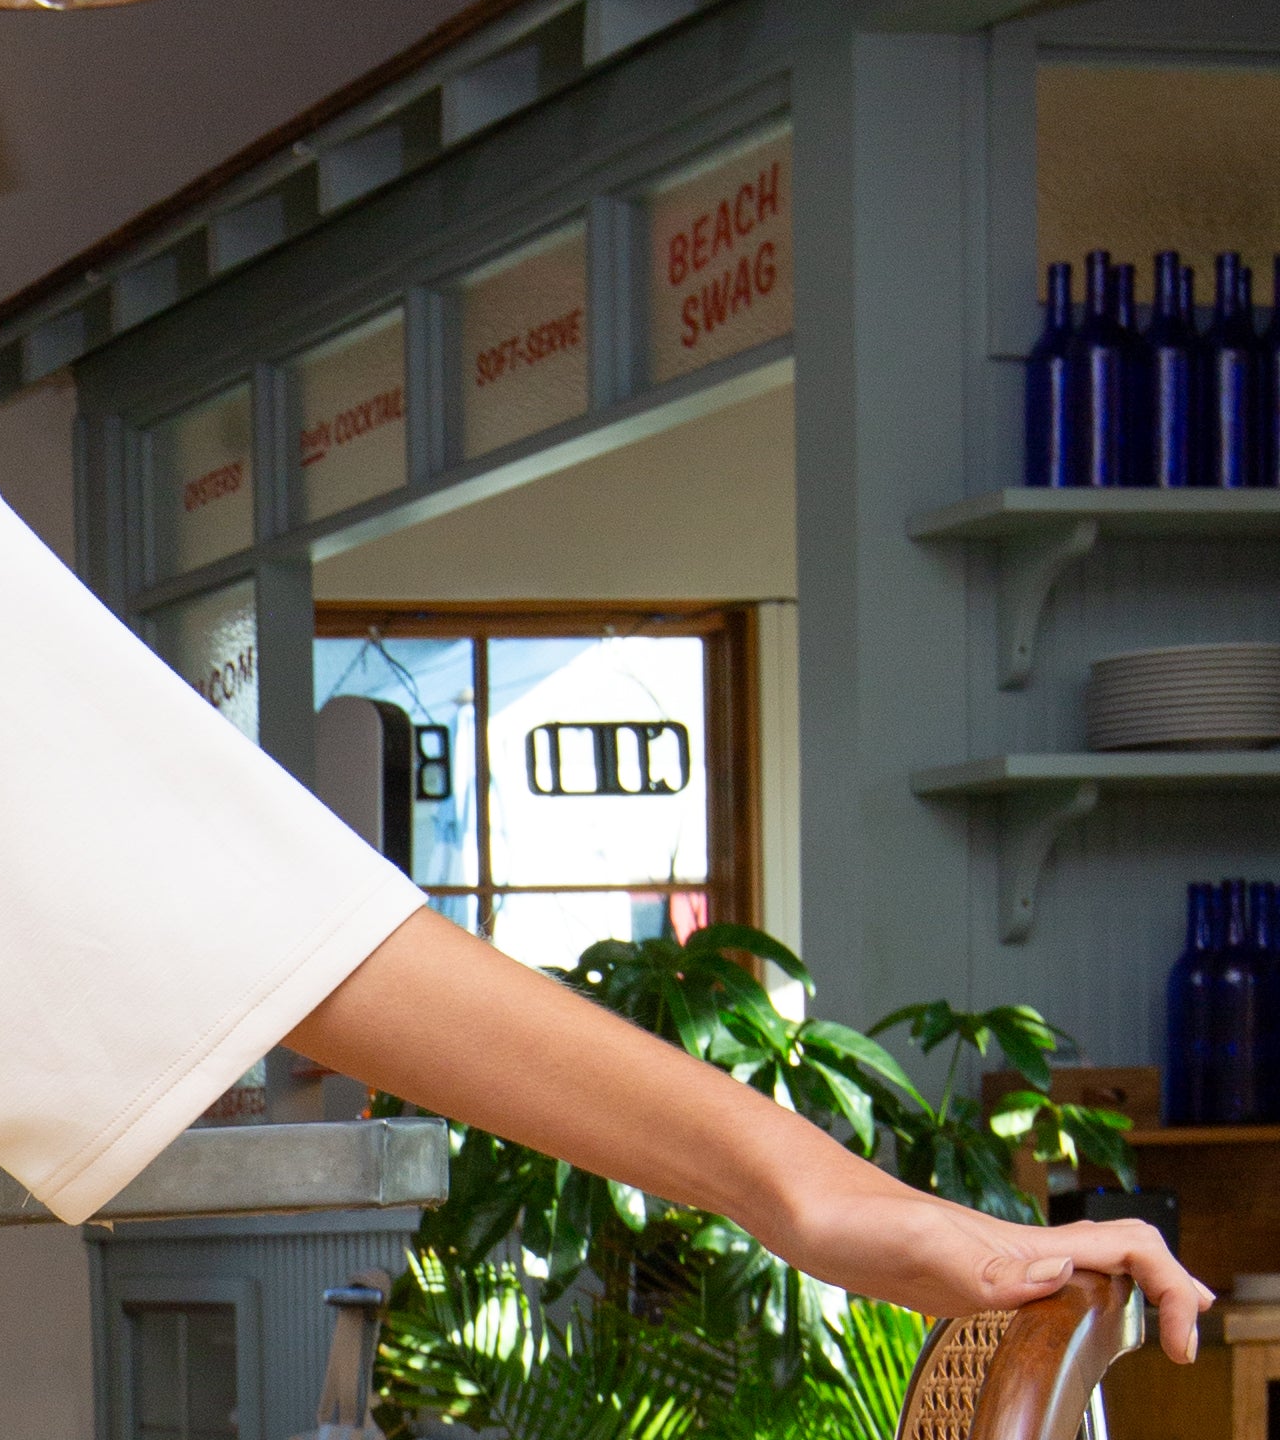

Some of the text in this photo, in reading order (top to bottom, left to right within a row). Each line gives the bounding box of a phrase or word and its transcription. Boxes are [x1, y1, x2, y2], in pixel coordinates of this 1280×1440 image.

[668, 162, 779, 286] BEACH
[475, 307, 583, 387] SOFT-SERVE
[681, 241, 777, 349] SWAG
